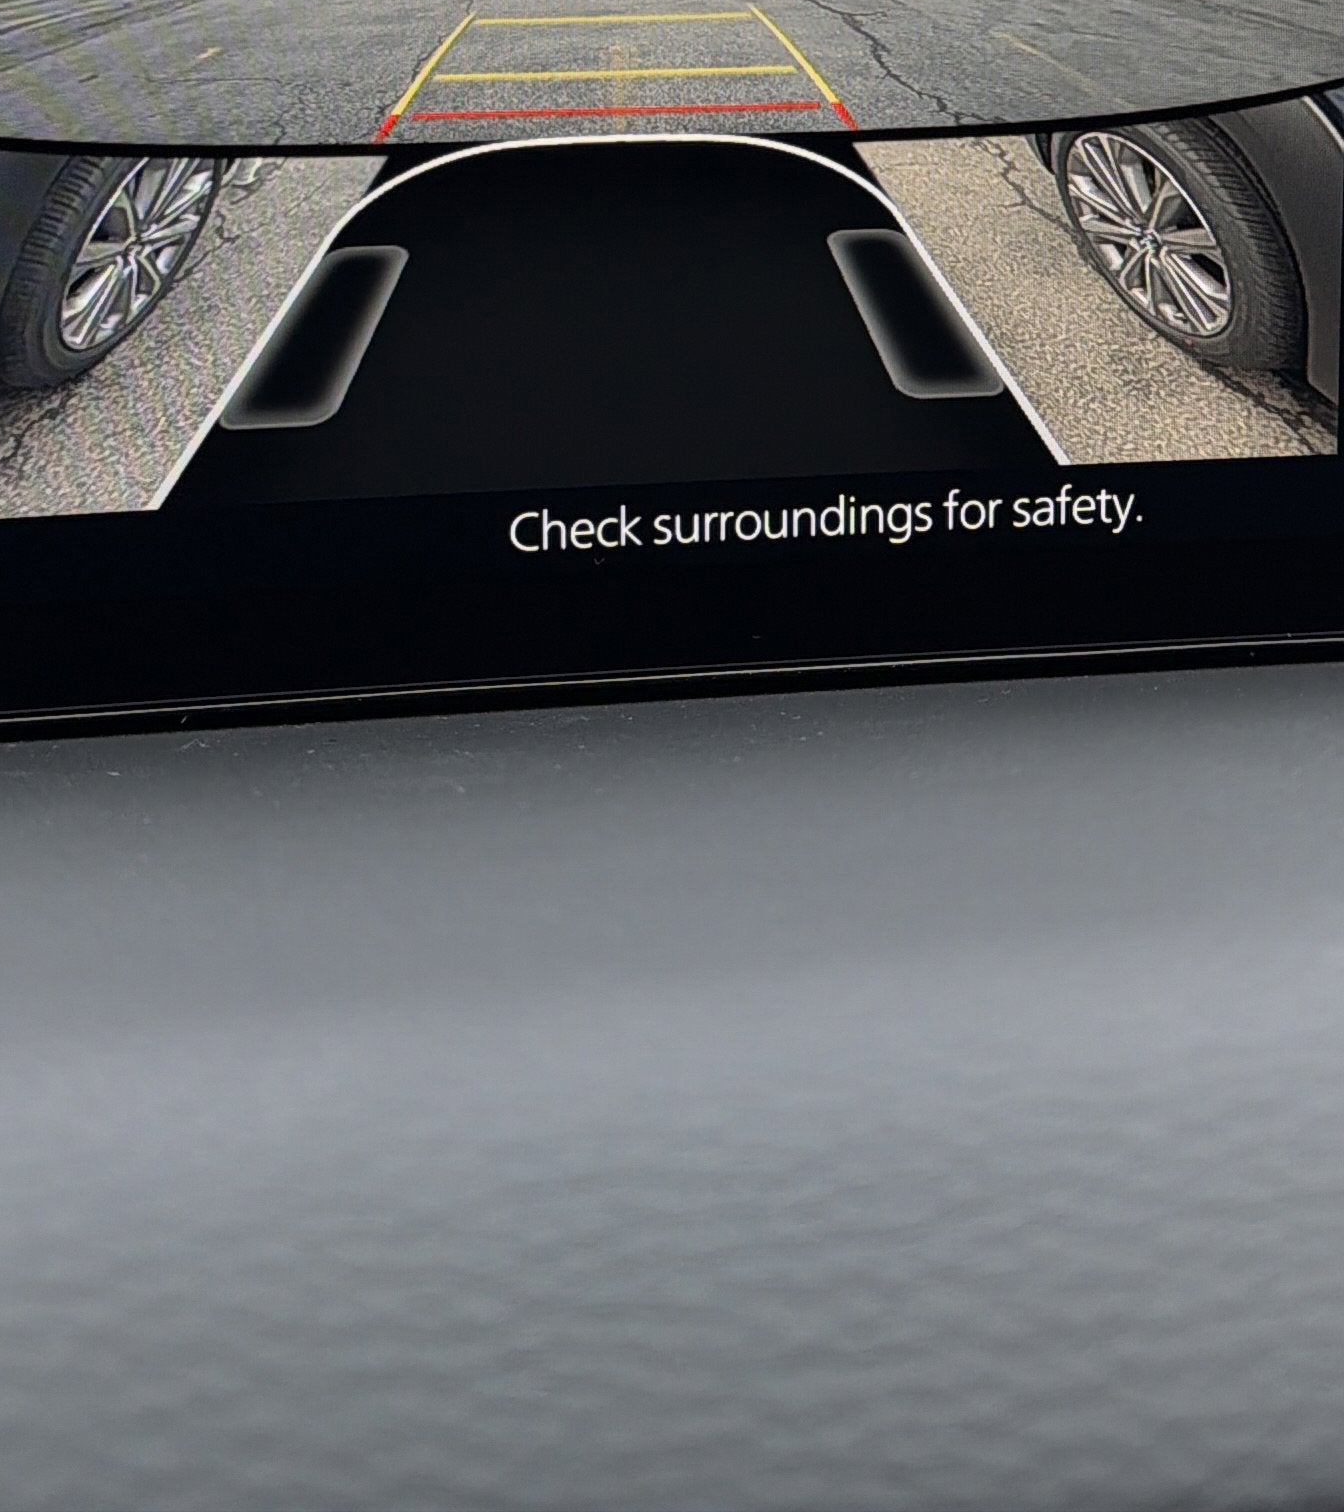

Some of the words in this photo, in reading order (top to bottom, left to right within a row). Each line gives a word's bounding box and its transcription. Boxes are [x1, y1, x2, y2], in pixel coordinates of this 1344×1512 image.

[509, 504, 644, 552] Check
[653, 493, 934, 544] surroundings
[942, 488, 1003, 531] for
[1012, 483, 1144, 534] safety.
